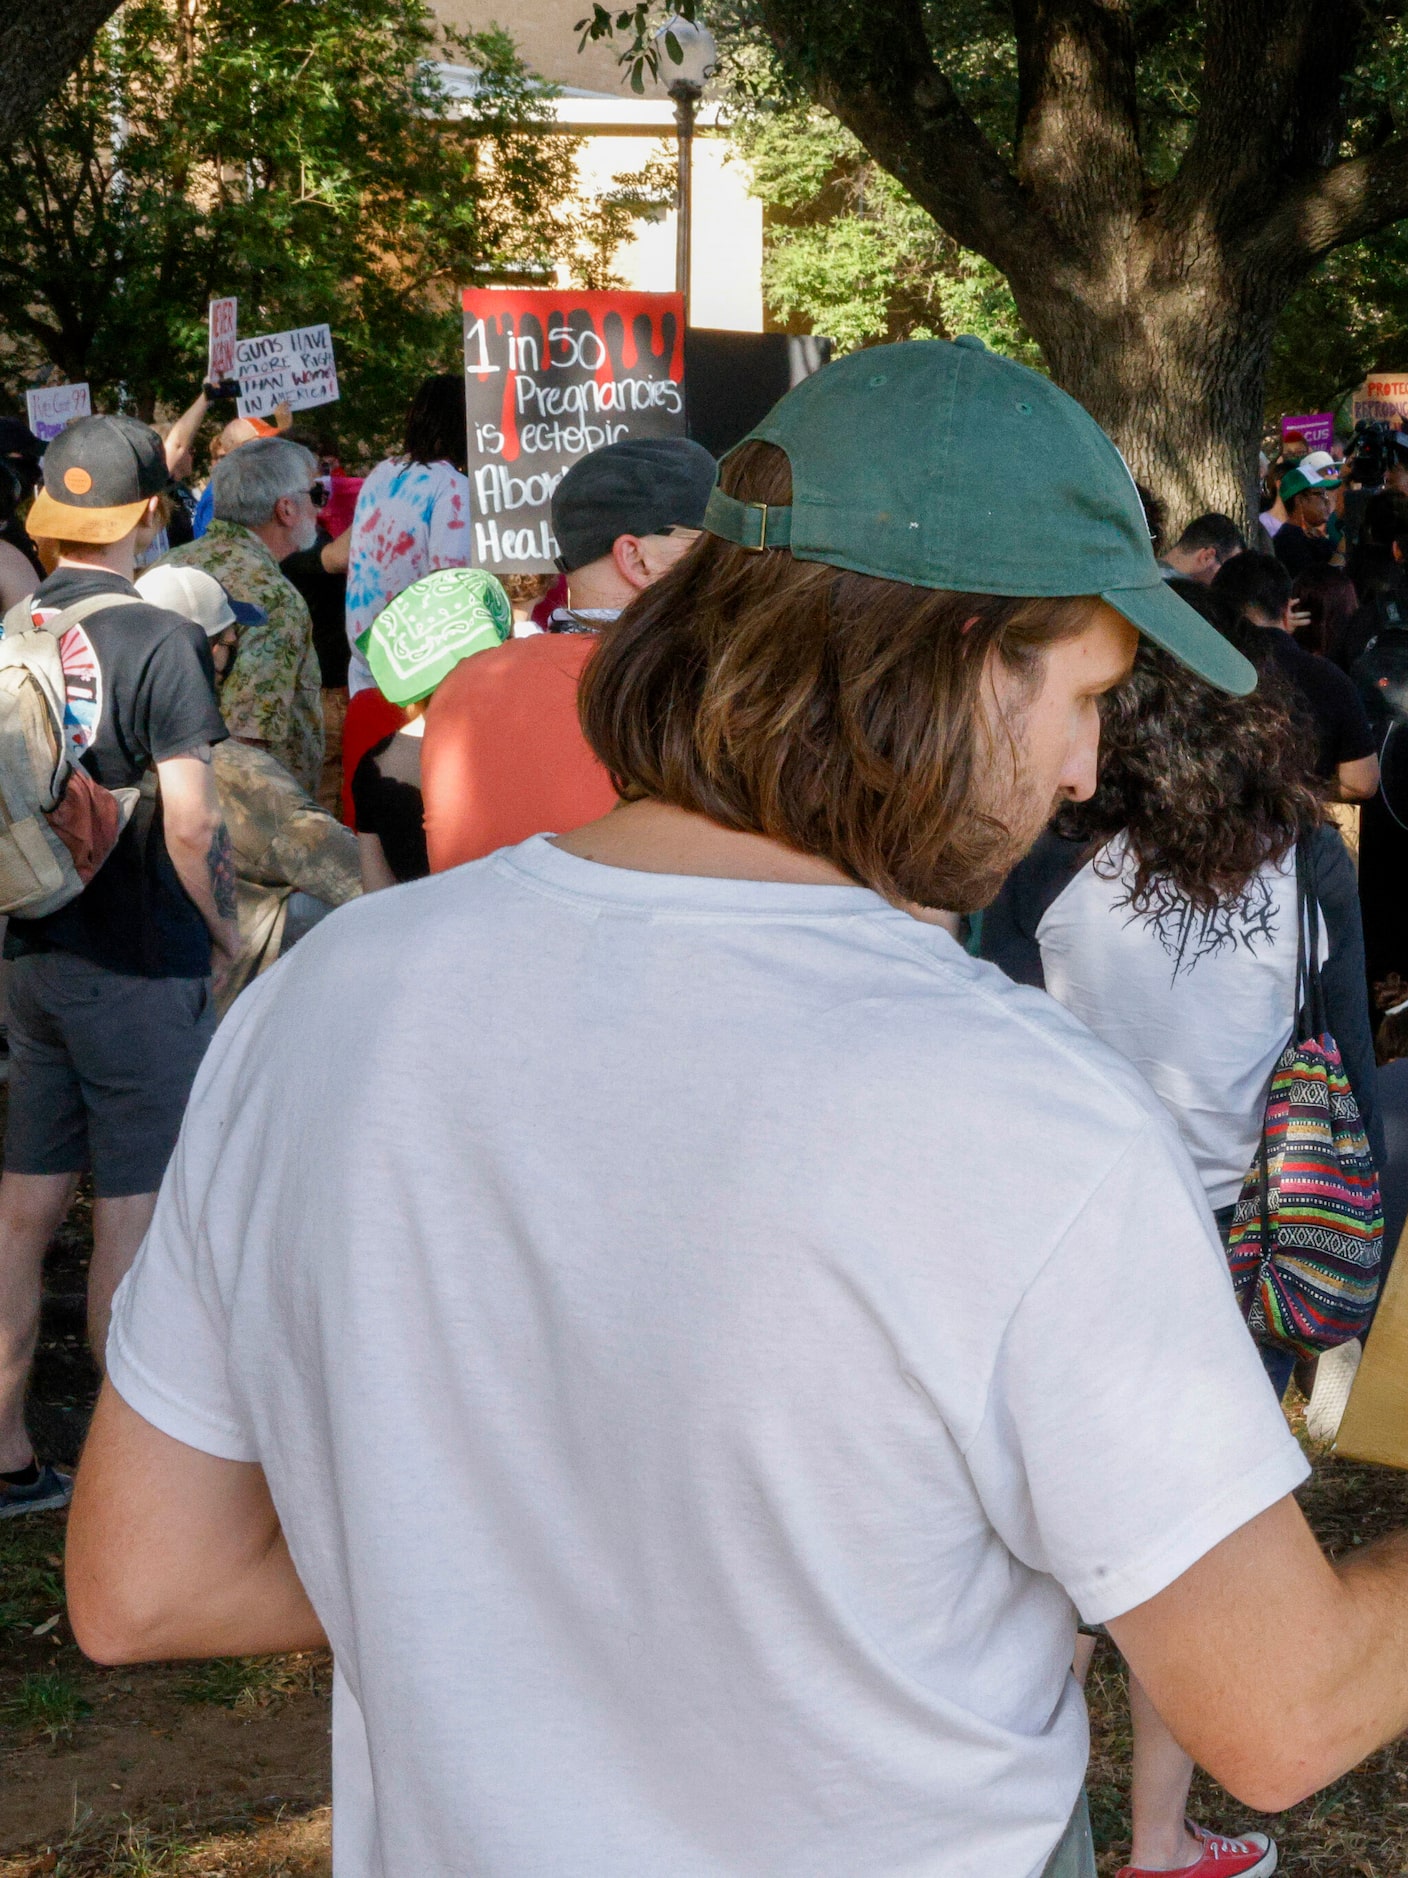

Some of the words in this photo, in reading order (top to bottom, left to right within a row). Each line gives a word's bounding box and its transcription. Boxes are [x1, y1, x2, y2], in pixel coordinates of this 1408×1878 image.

[467, 318, 500, 373] 1
[507, 330, 539, 372] in
[548, 327, 606, 370] 50
[244, 373, 284, 394] THAN
[514, 373, 682, 432] Pregnancies
[244, 396, 263, 414] IN
[475, 420, 505, 453] is
[474, 463, 570, 515] Abor
